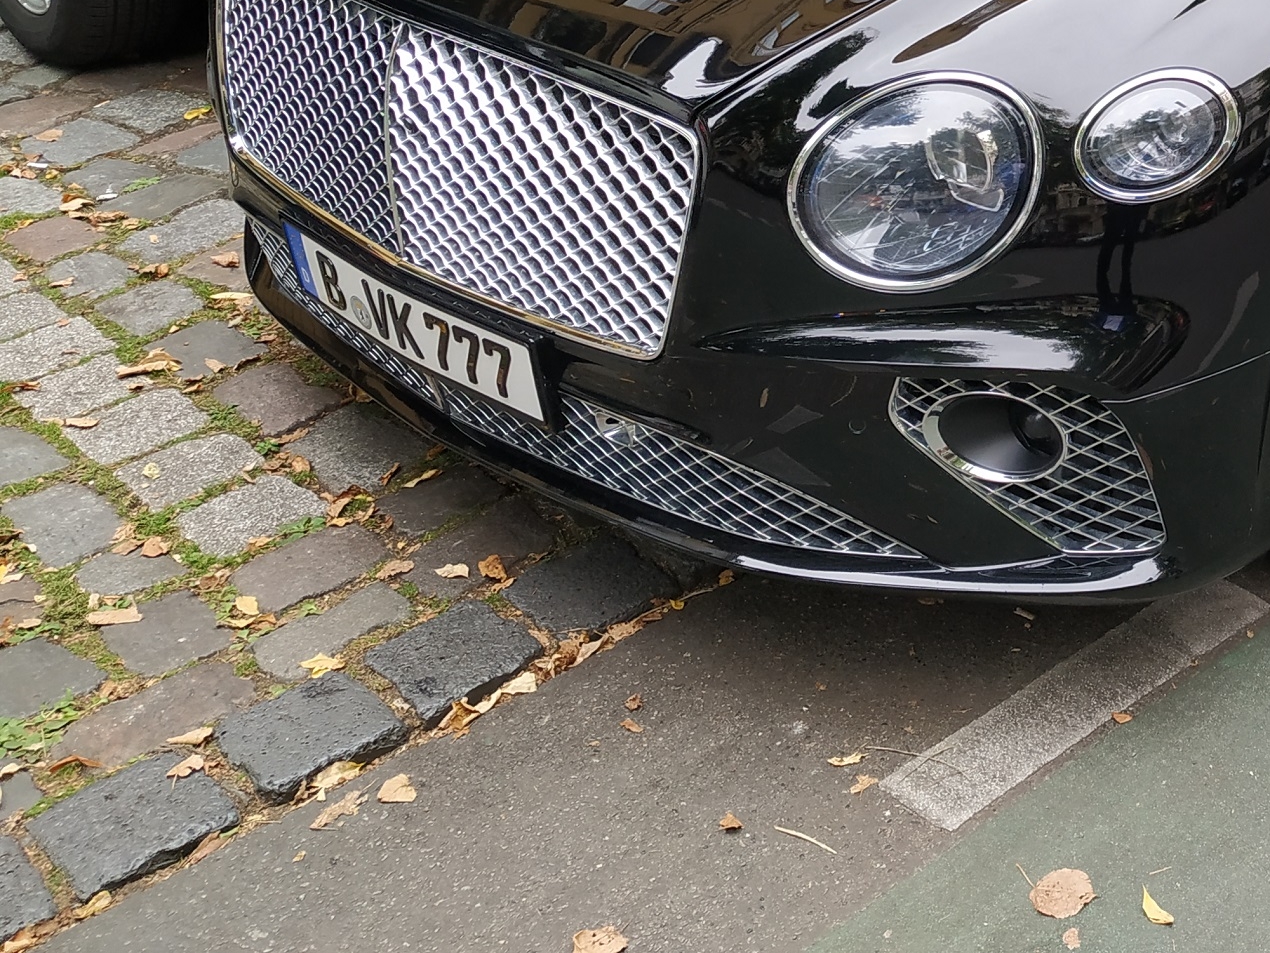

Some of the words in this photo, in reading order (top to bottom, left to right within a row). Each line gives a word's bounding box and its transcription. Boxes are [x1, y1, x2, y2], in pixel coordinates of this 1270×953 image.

[315, 250, 347, 311] B
[361, 278, 425, 360] VK
[422, 311, 512, 399] 777
